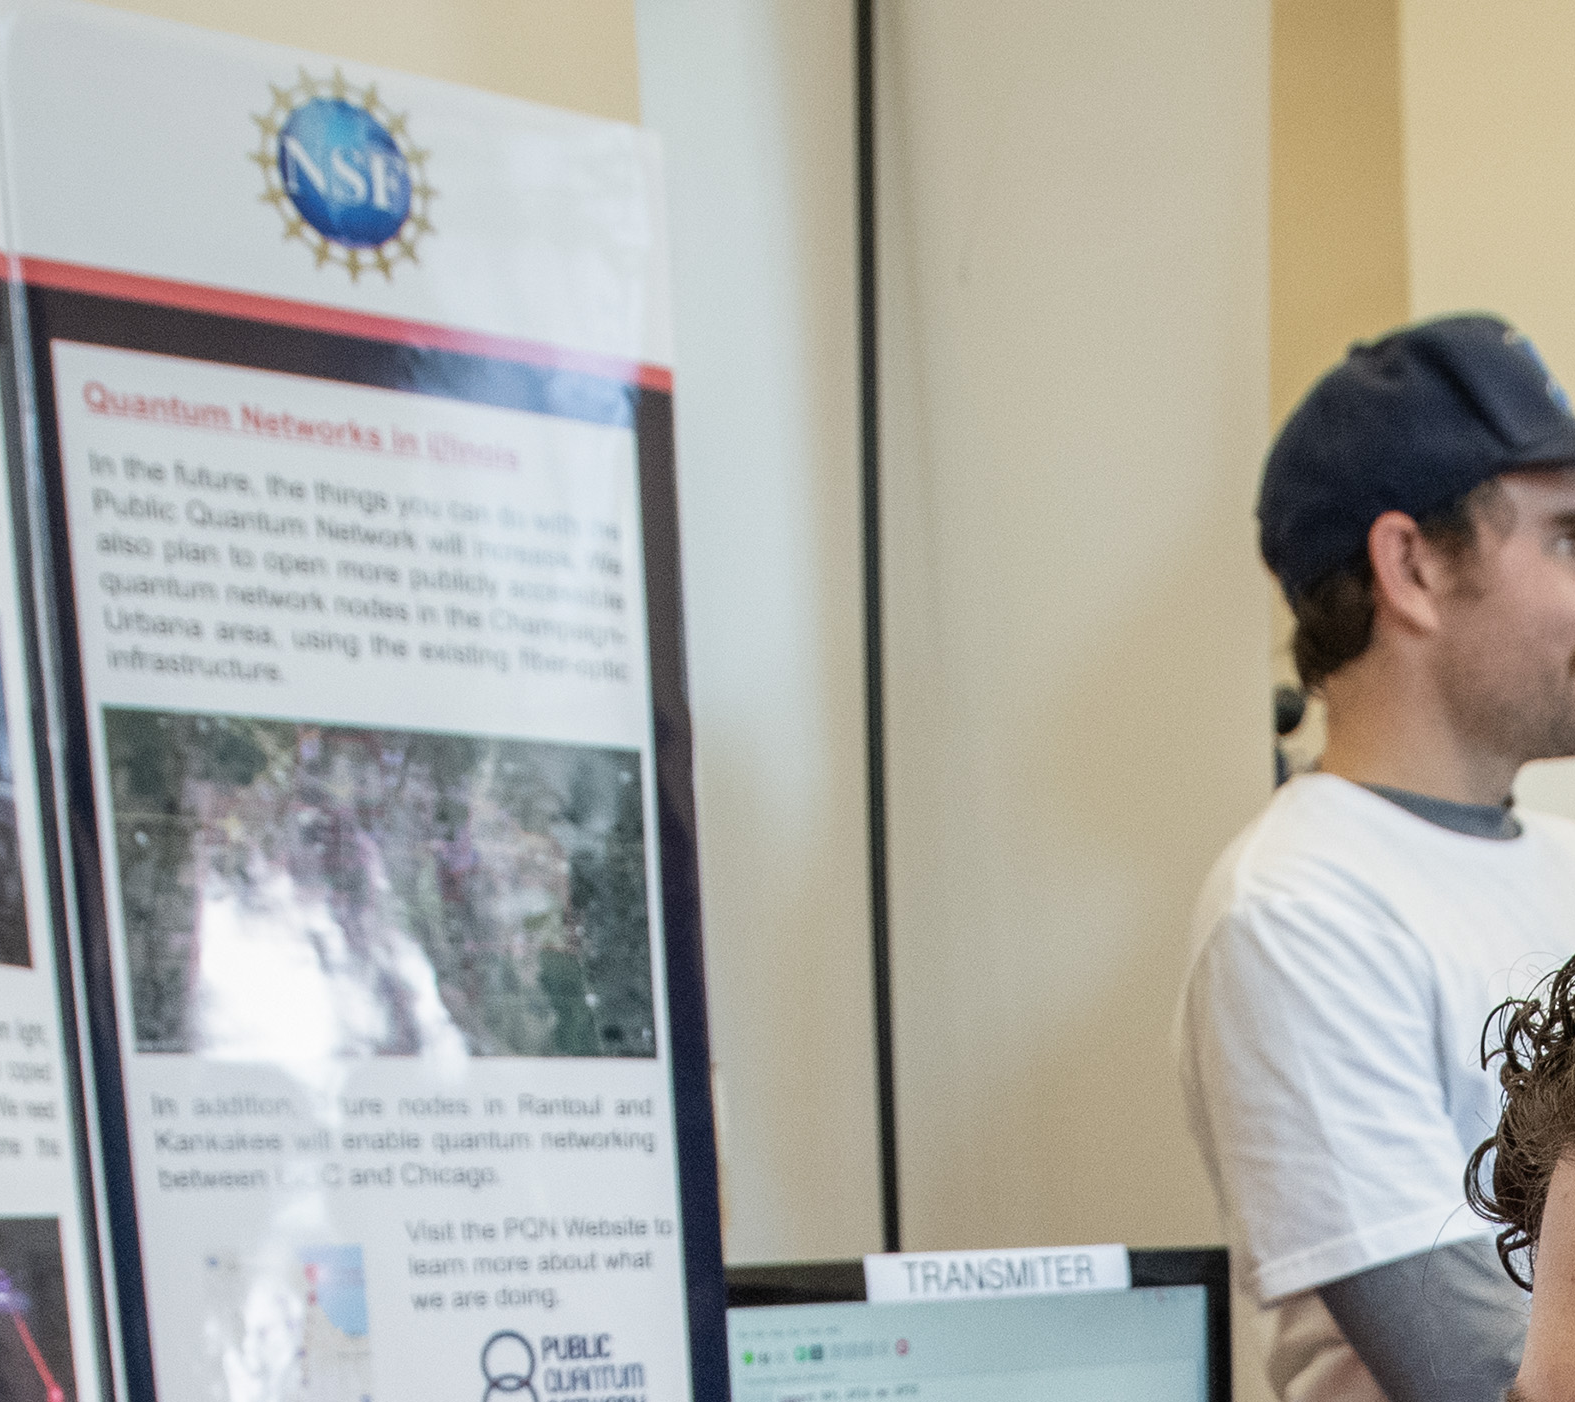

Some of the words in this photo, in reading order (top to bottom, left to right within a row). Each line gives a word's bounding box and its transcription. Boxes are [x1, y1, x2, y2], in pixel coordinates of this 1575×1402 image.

[281, 134, 411, 213] NSF
[903, 1255, 1096, 1295] TRANSMITER
[541, 1334, 612, 1362] PUBLIC
[545, 1364, 645, 1393] QUANTUM
